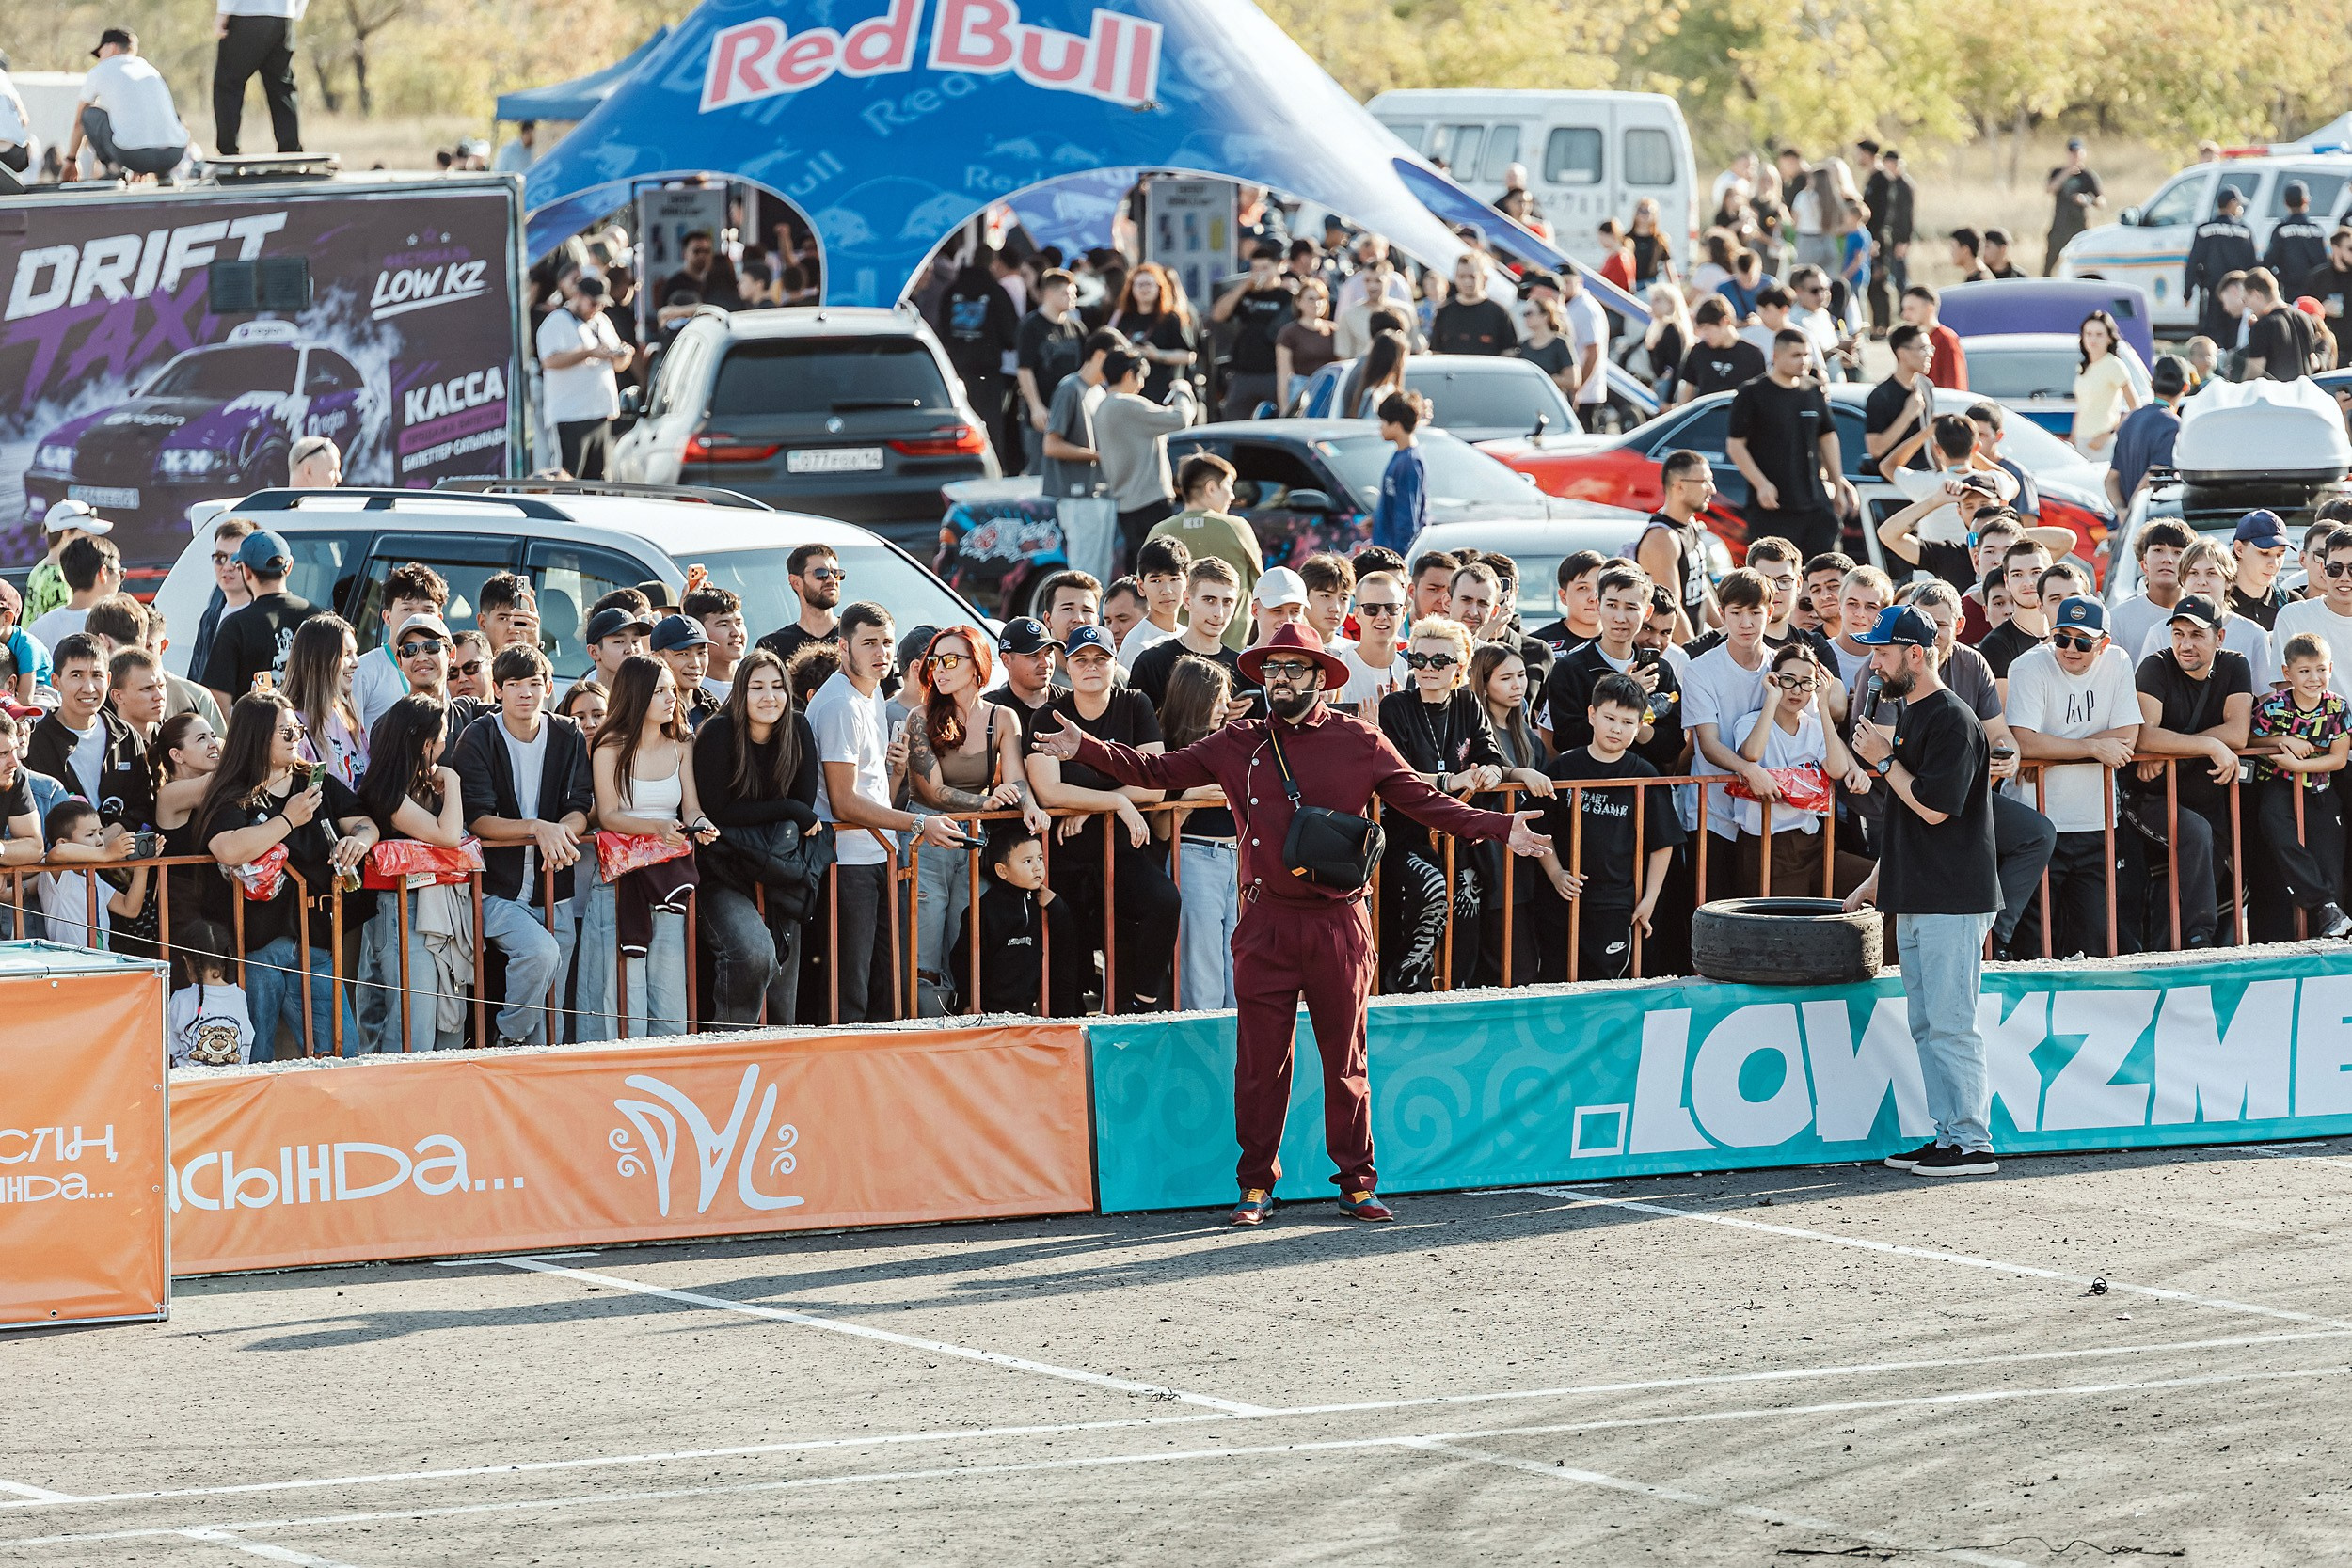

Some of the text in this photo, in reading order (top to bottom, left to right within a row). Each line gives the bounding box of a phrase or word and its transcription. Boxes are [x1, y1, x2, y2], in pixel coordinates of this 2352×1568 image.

[703, 0, 919, 110] Red
[930, 0, 1160, 104] Bull
[4, 211, 289, 322] DRIFT
[369, 259, 487, 309] LOW KZ
[404, 365, 506, 427] КАССА
